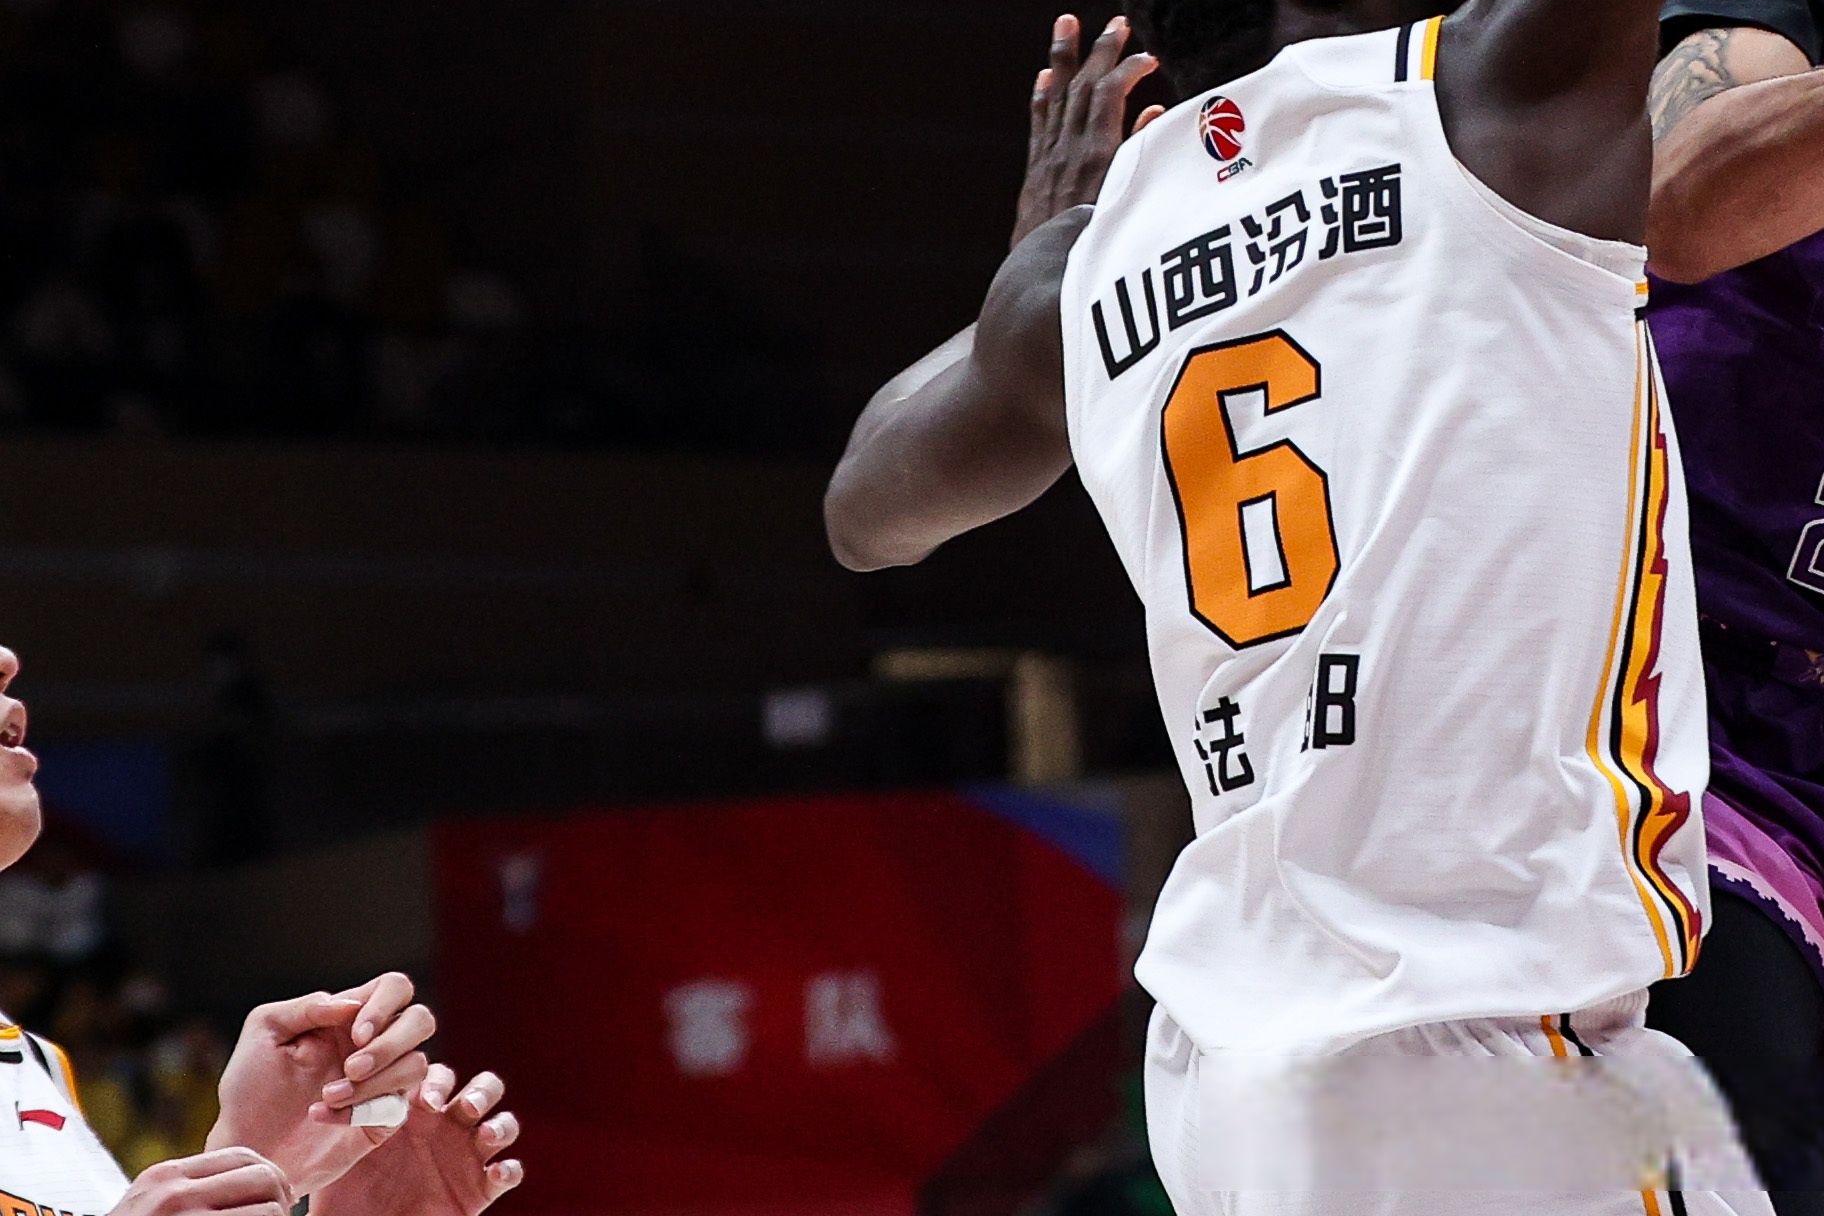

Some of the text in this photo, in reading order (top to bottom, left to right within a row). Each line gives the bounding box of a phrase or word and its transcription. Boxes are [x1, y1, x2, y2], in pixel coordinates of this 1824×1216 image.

[1090, 163, 1403, 381] 山西汾酒
[1216, 157, 1253, 182] CBA
[1160, 327, 1341, 651] 6
